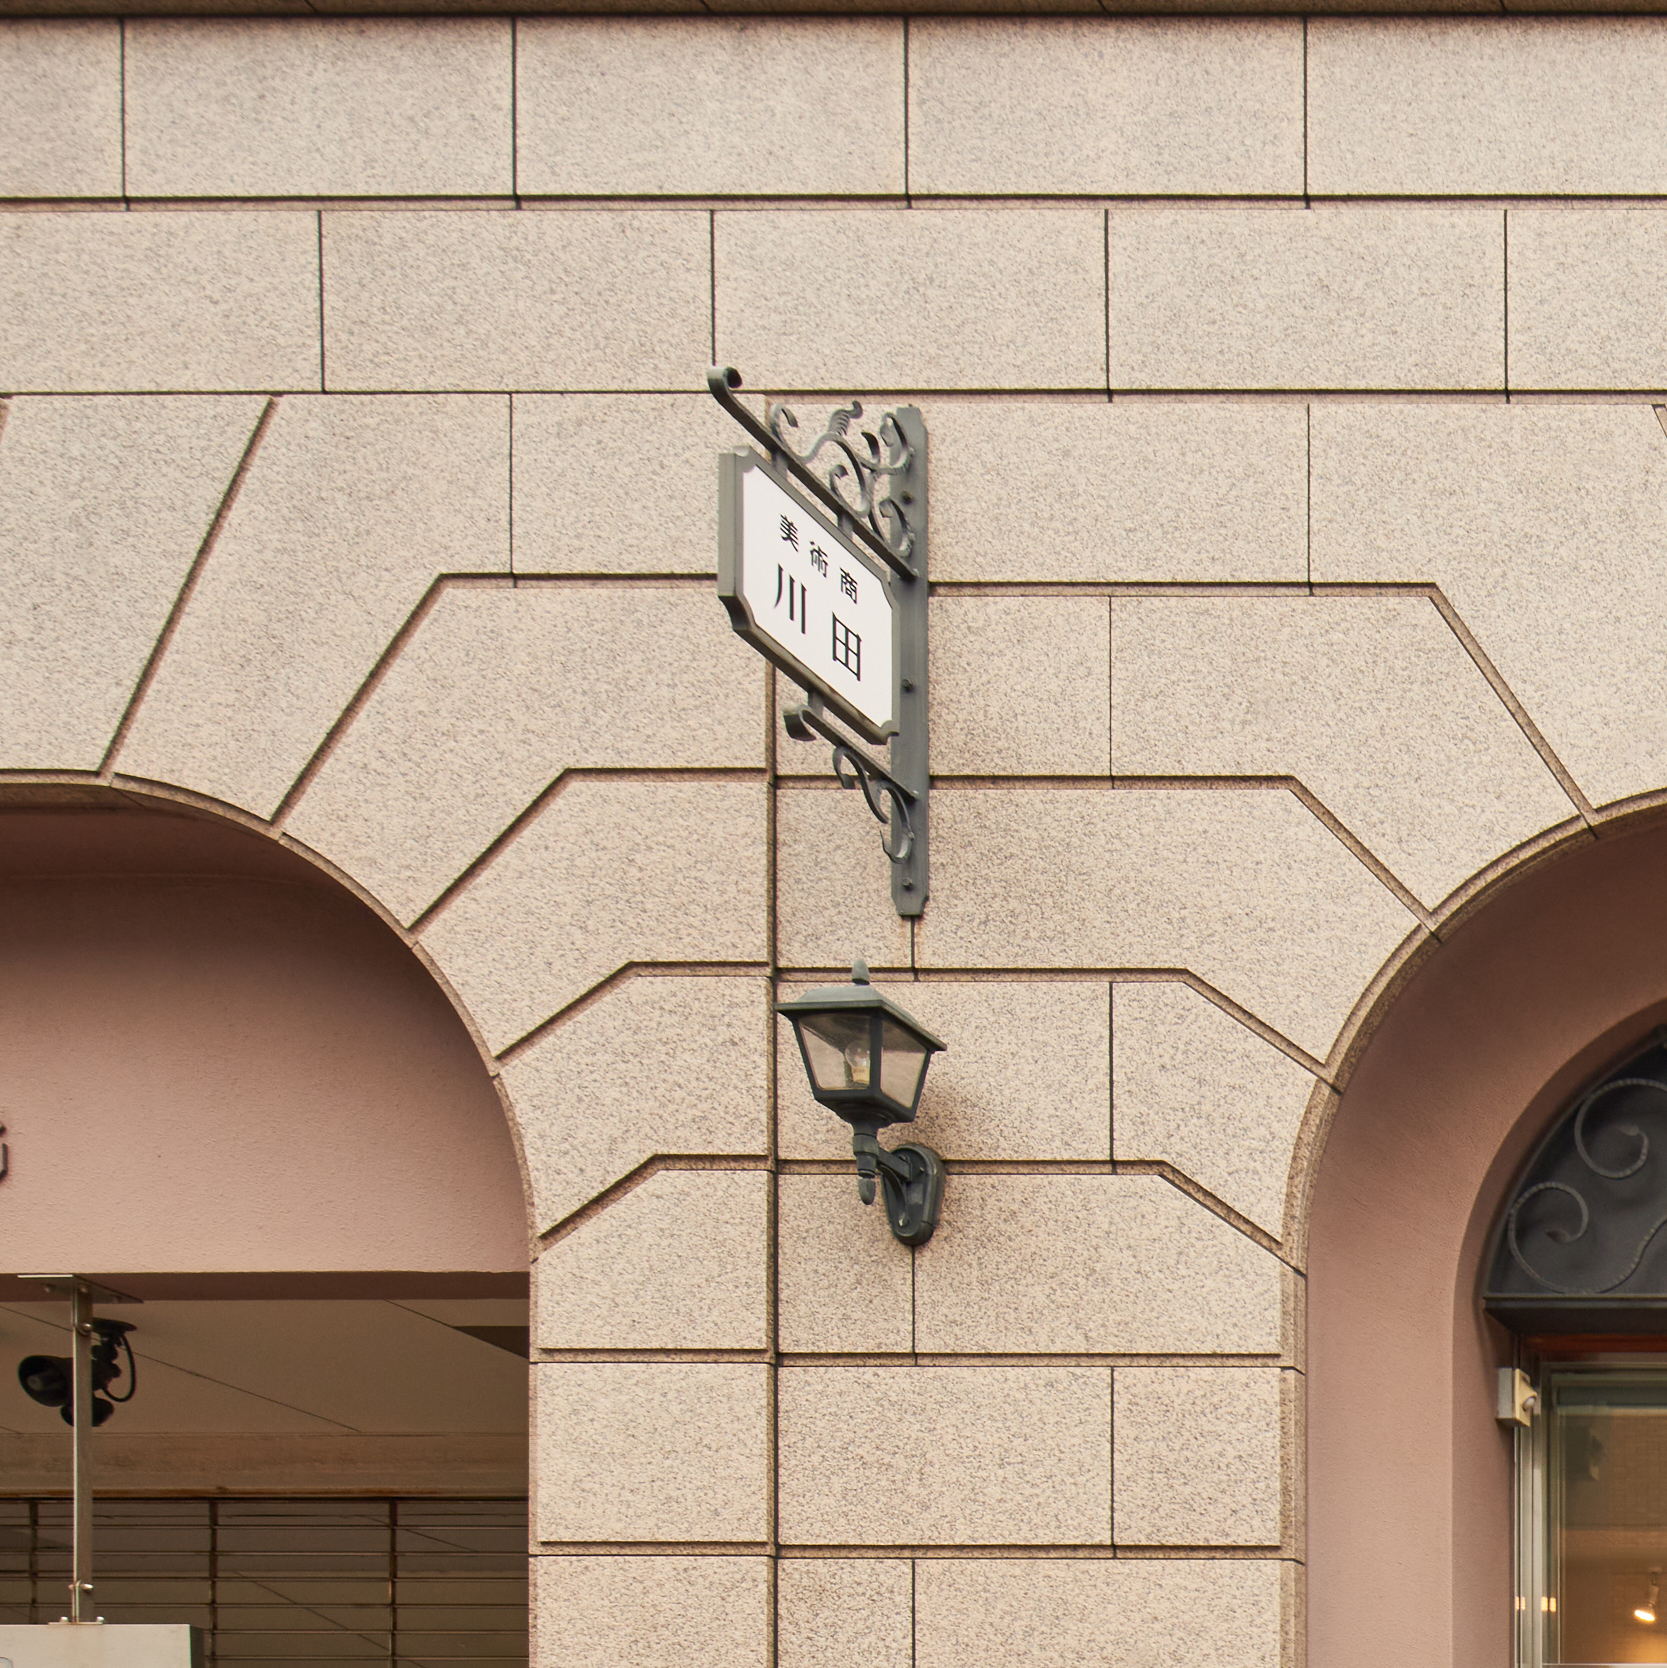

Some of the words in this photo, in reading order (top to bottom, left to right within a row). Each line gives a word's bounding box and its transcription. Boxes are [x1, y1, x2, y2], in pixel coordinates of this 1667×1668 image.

[779, 514, 858, 604] 美術商
[774, 563, 861, 681] 川田
